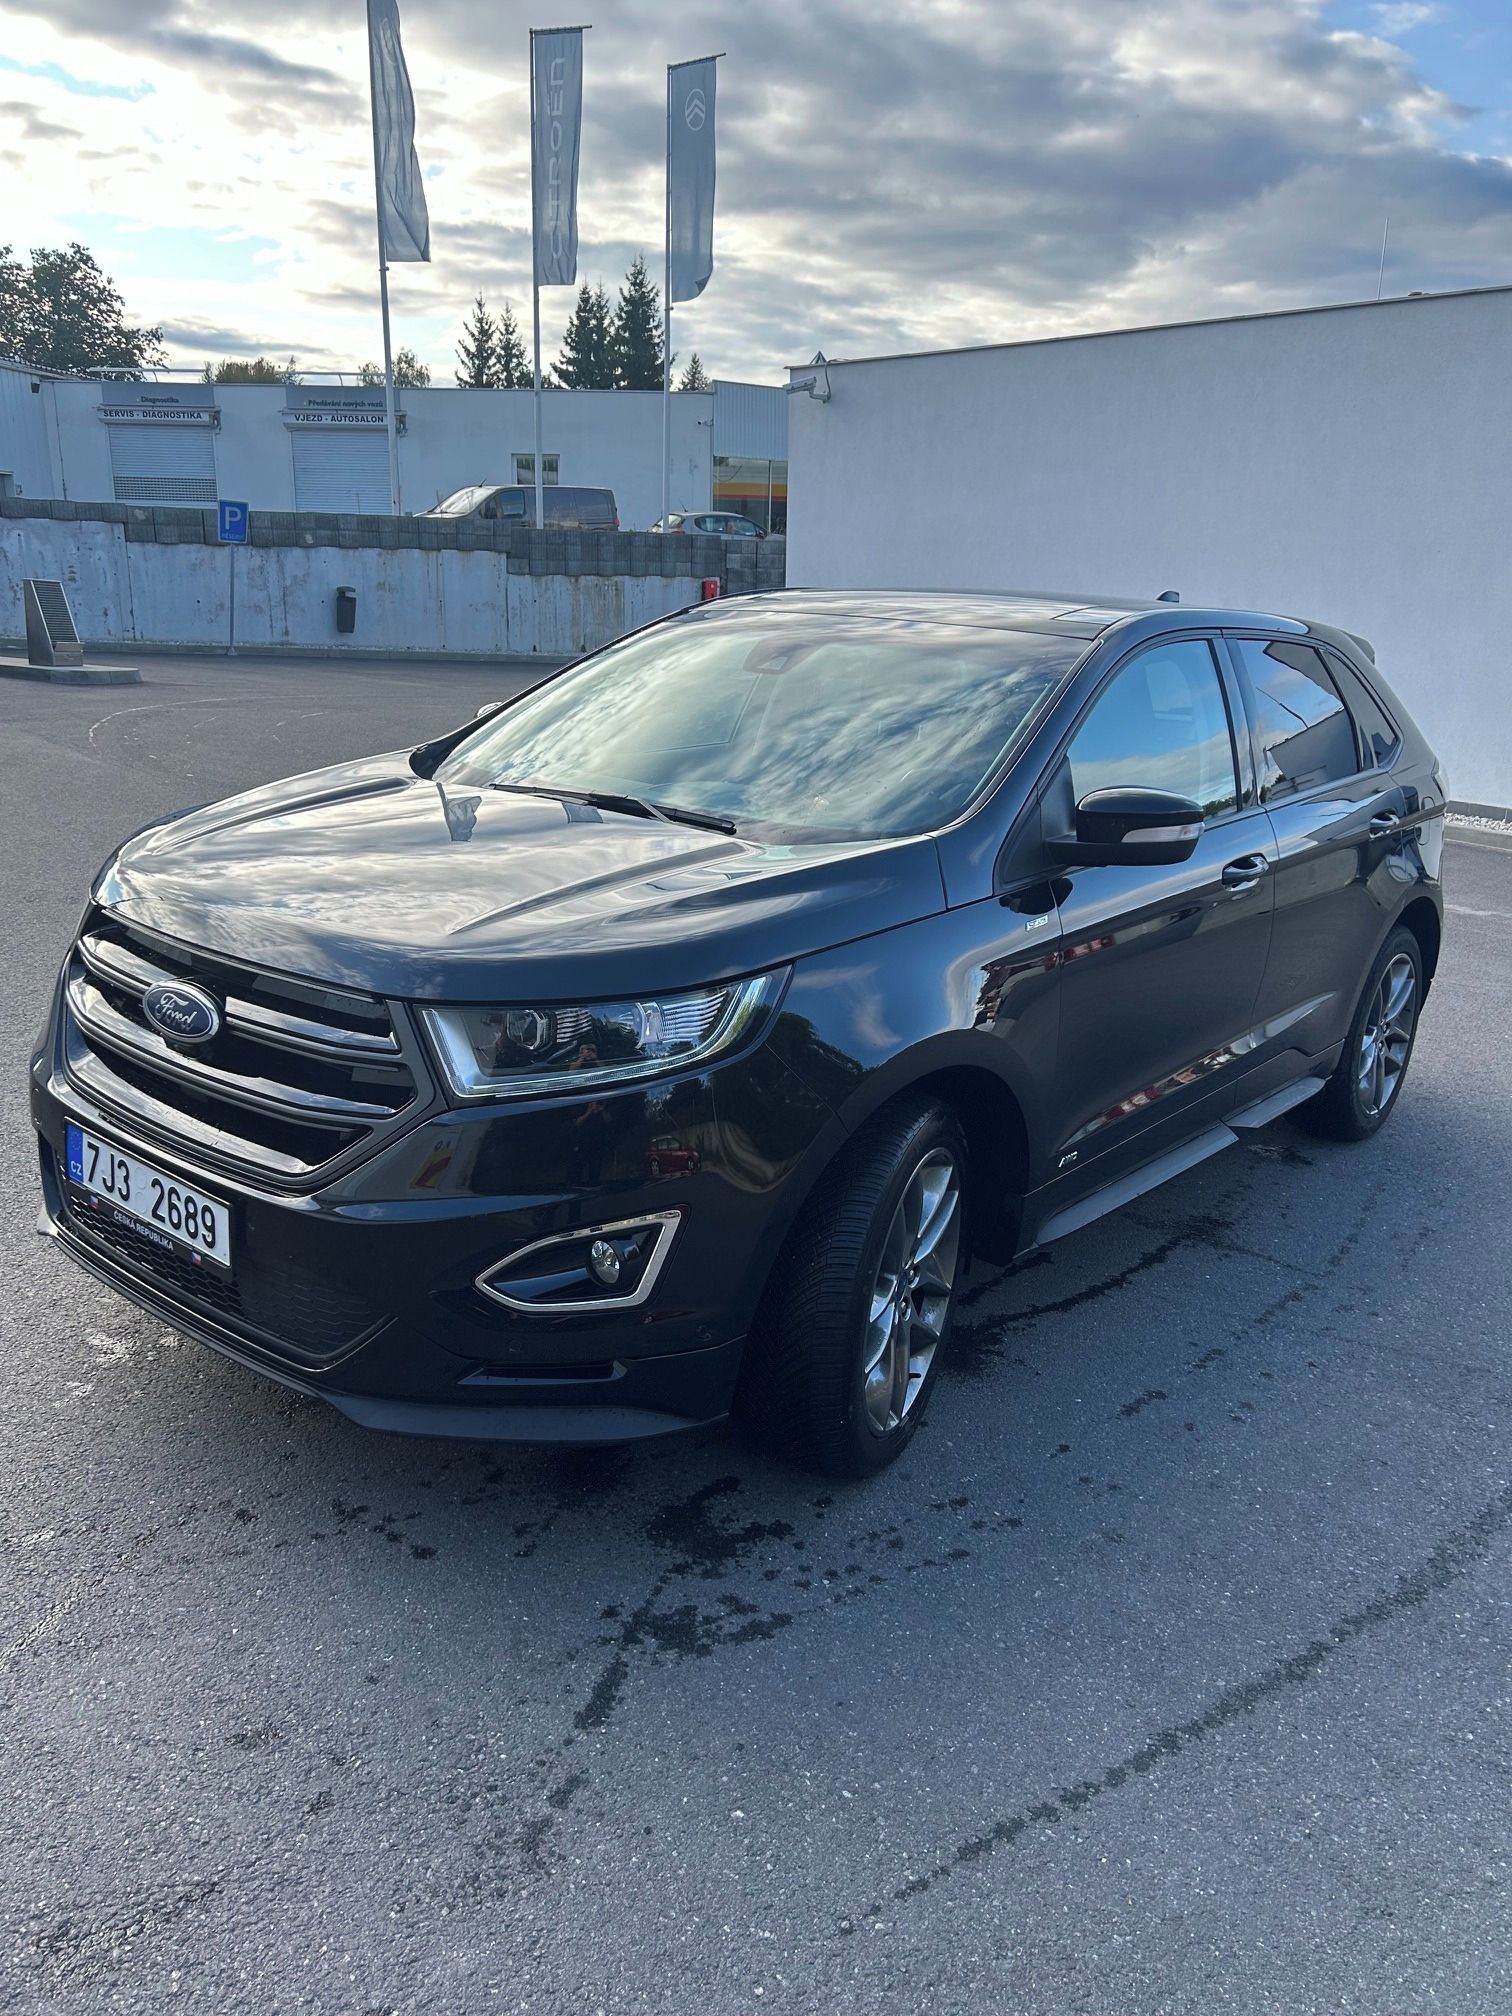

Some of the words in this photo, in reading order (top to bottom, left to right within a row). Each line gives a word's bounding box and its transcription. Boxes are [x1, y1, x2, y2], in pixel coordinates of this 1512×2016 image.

[103, 410, 135, 418] SERVIS
[142, 411, 202, 419] DIAGNOSTIKA
[294, 414, 323, 422] VJEZD
[331, 415, 384, 423] AUTOSALON
[225, 506, 241, 530] P
[155, 992, 198, 1024] Ford
[70, 1160, 83, 1176] CZ
[86, 1141, 131, 1202] 7J3
[151, 1177, 217, 1249] 2689
[136, 1222, 174, 1251] REPUBLIKA
